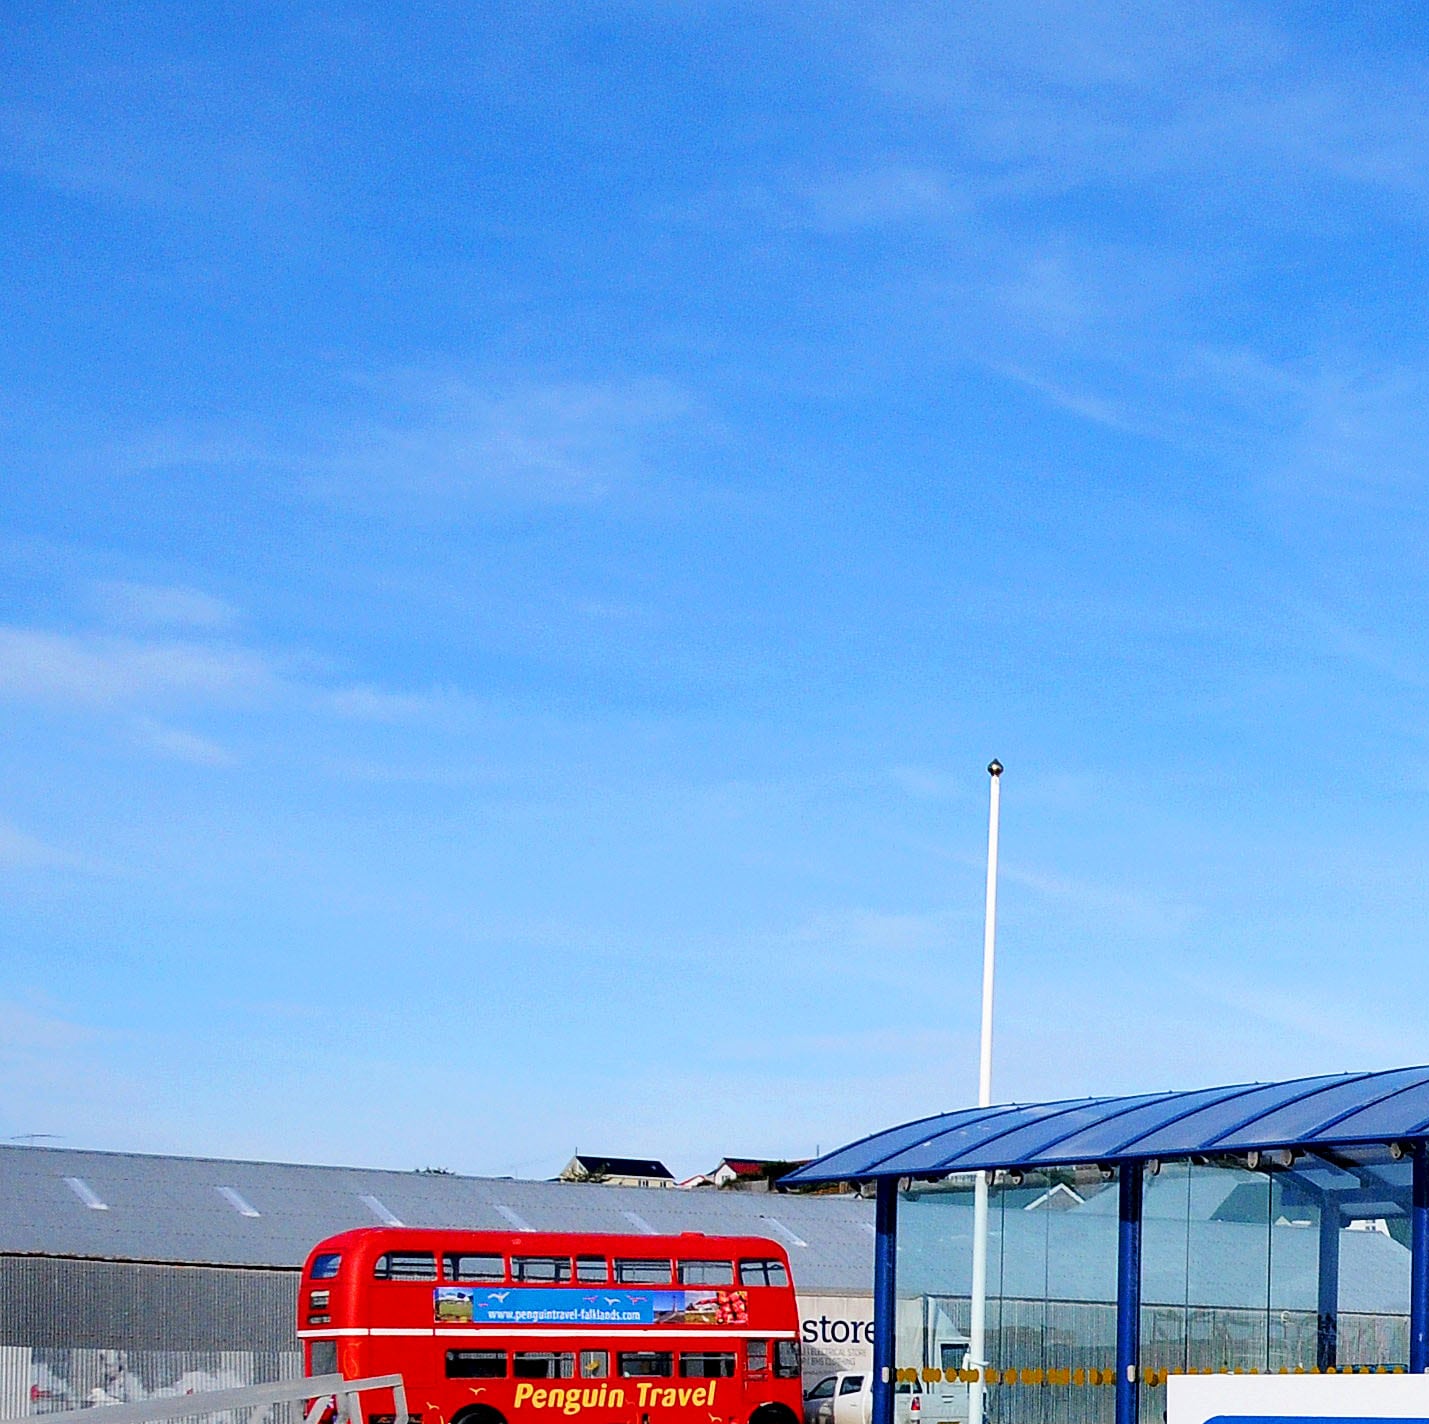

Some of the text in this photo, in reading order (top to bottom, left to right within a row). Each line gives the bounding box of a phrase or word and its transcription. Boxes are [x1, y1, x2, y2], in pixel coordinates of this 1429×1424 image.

[487, 1308, 641, 1322] www.penguintravel-falklands.com
[514, 1380, 717, 1415] Penguin Travel
